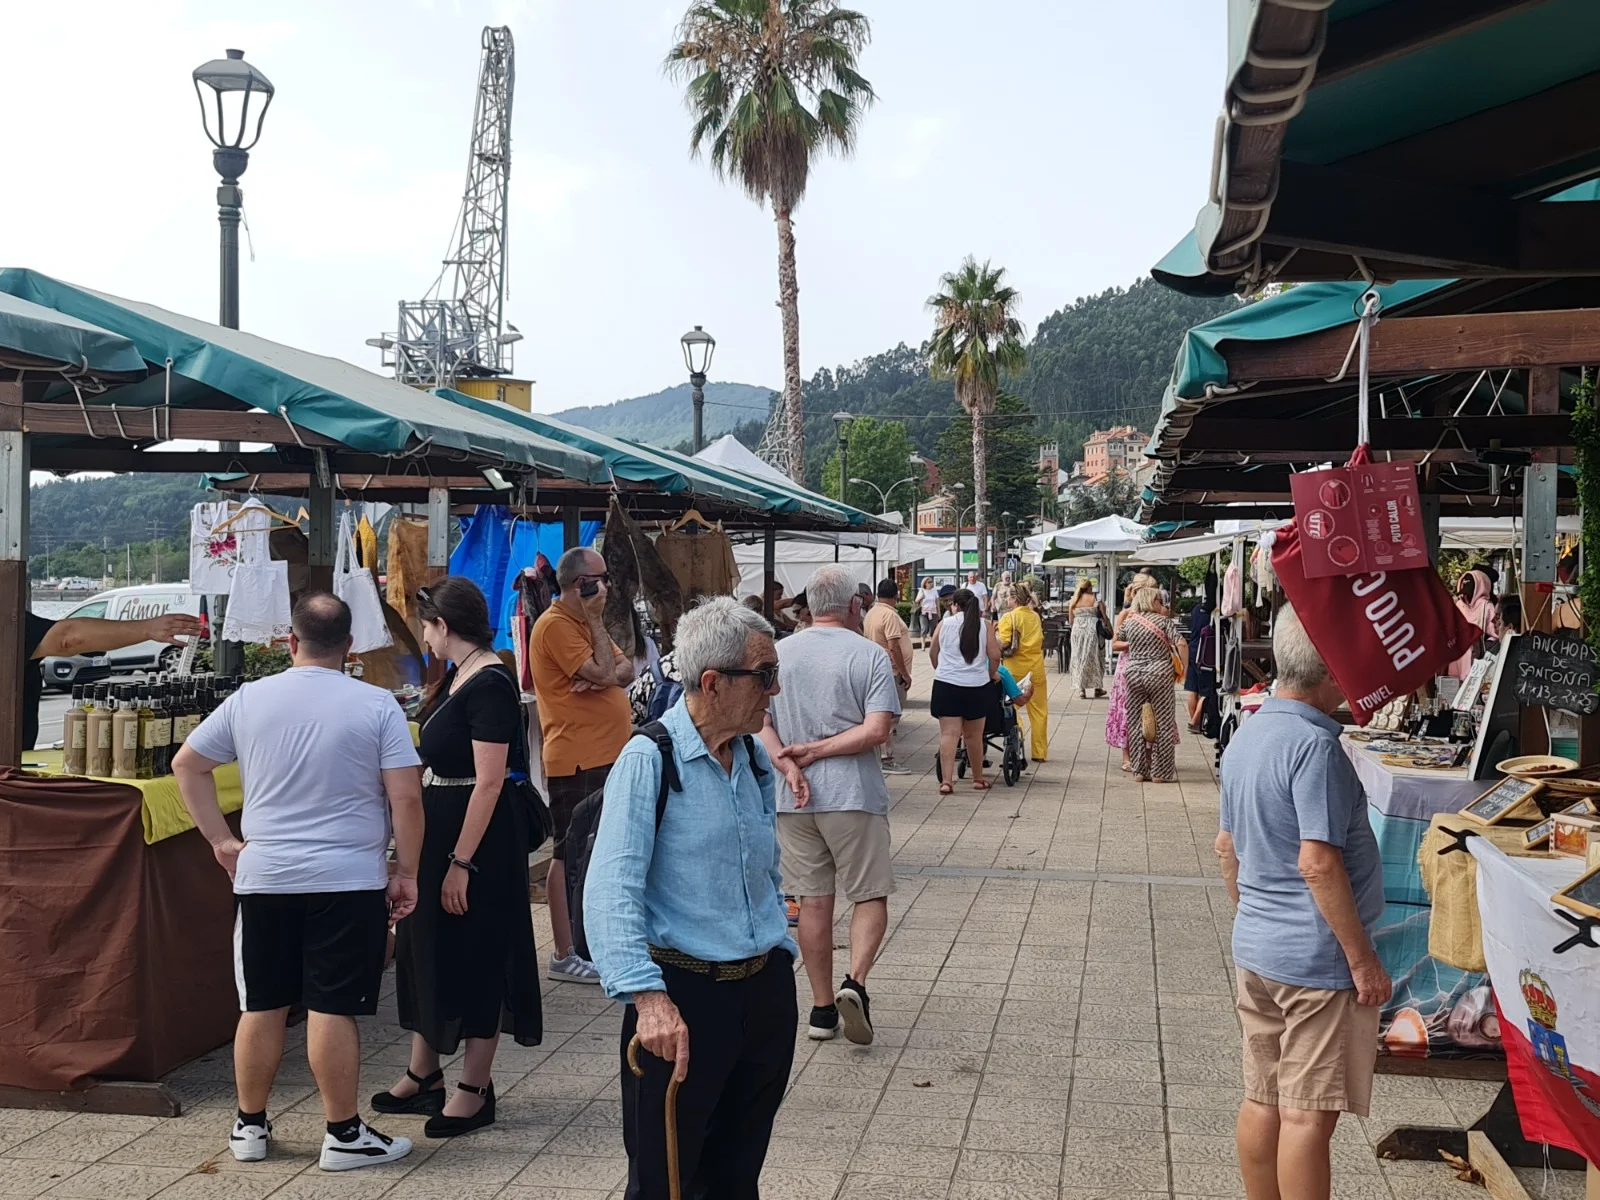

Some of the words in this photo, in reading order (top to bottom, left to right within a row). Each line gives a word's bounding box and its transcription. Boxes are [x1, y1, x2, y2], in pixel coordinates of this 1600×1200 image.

[1386, 500, 1399, 523] CALOR
[1390, 524, 1401, 543] PUTO
[118, 597, 171, 621] Aimar
[1365, 590, 1426, 672] PUTO
[1532, 635, 1598, 663] ANCHOAS
[1518, 662, 1591, 687] SANTOÑA
[1552, 656, 1569, 669] DE
[1356, 684, 1394, 712] TOWEL
